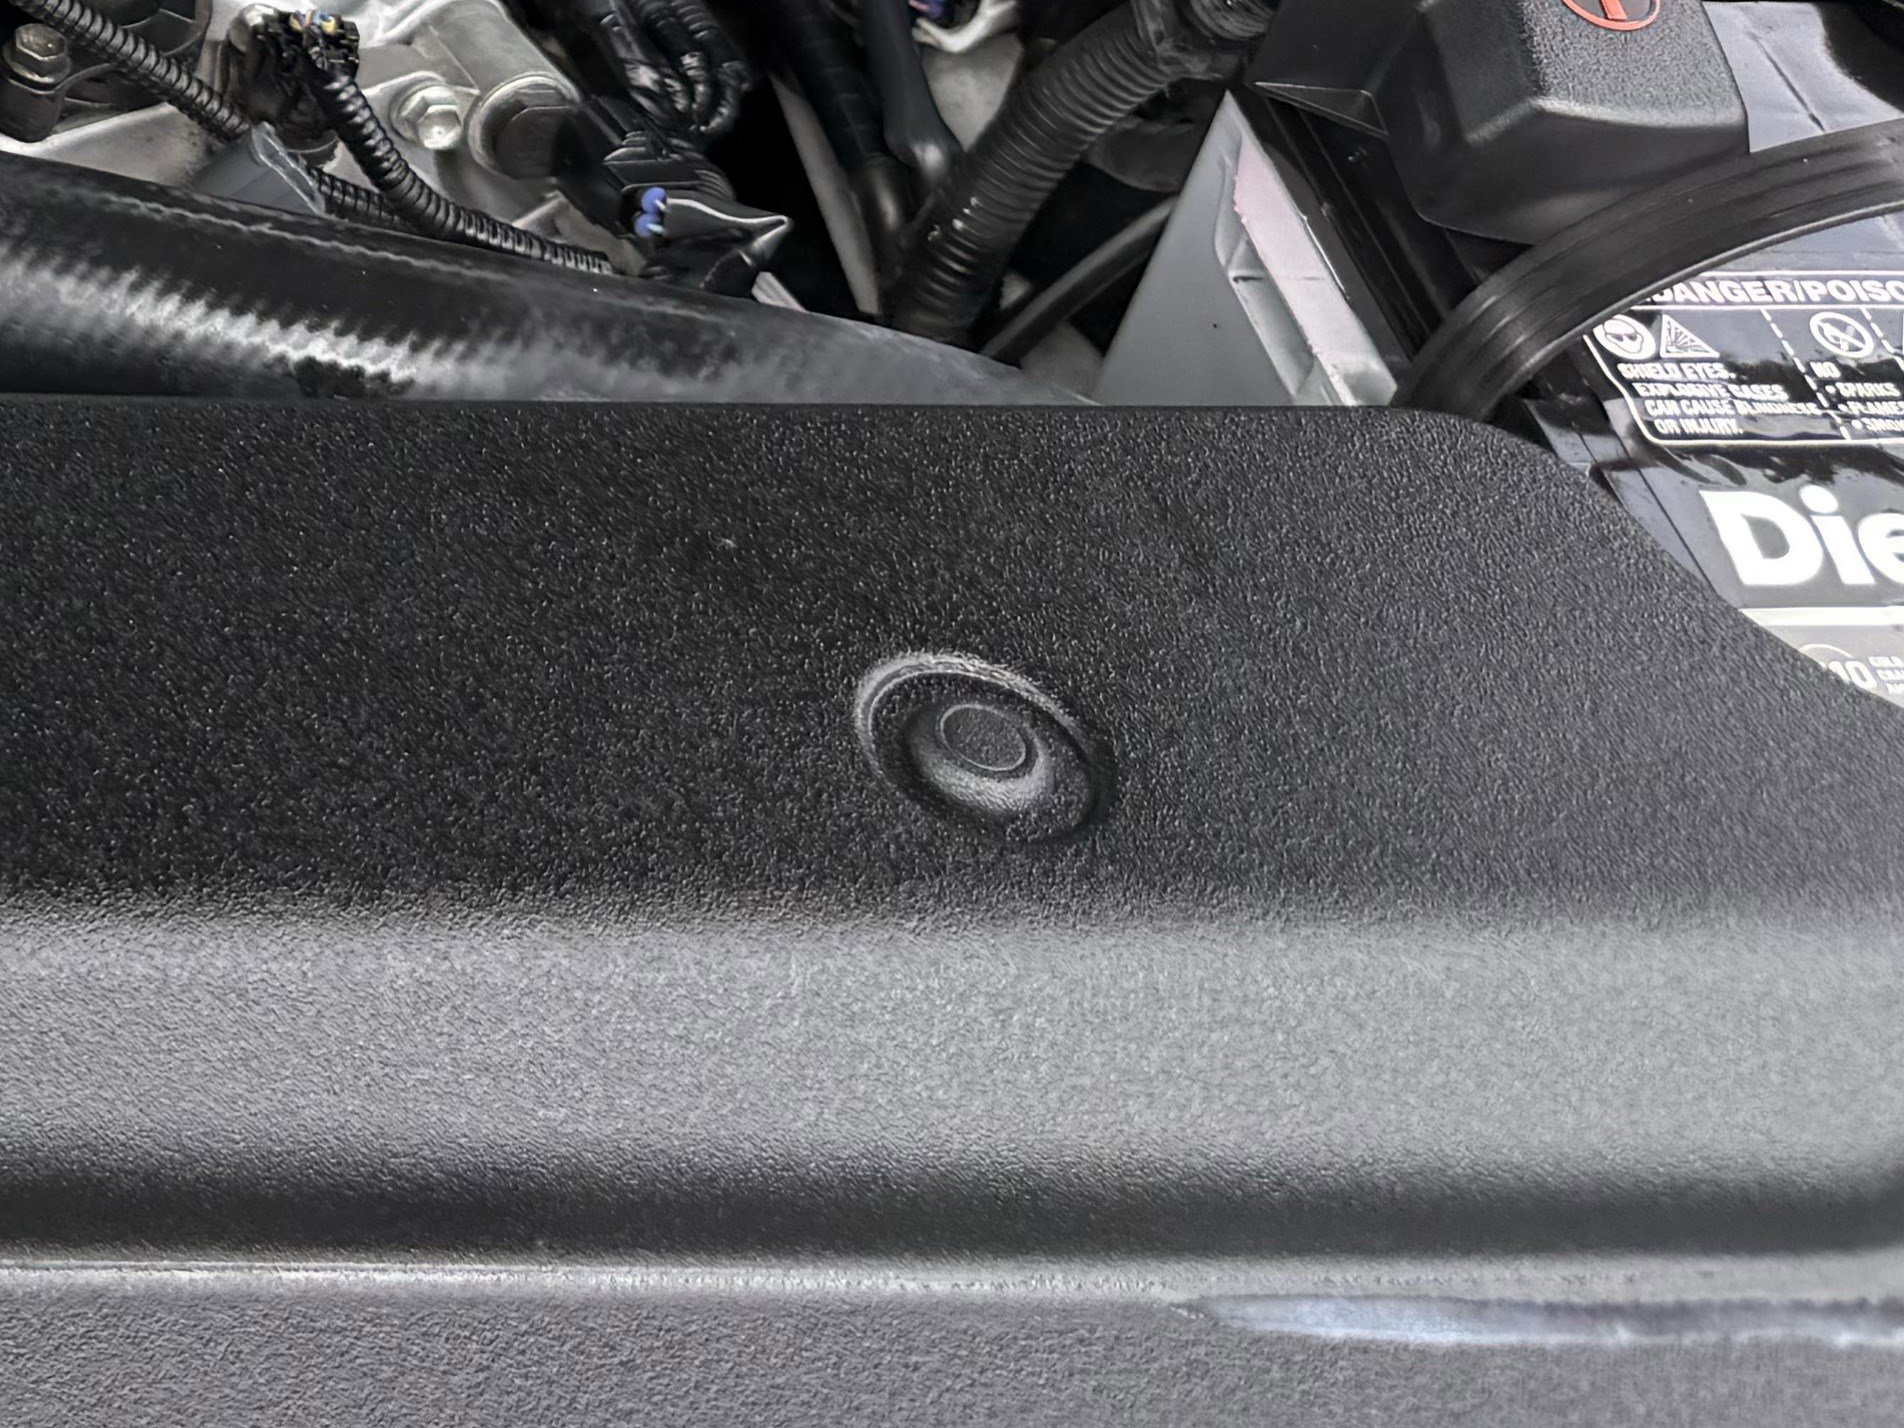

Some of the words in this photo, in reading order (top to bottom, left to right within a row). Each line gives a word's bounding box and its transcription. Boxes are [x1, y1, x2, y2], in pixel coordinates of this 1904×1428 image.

[1617, 362, 1682, 379] SHIELD
[1679, 362, 1737, 380] EYES.
[1809, 361, 1841, 379] NO
[1631, 382, 1732, 398] EXPLOSIVE
[1727, 384, 1790, 402] GASES
[1834, 381, 1902, 398] SPARKS
[1644, 399, 1681, 416] CAN
[1680, 399, 1736, 416] CAUSE
[1653, 417, 1682, 434] OR
